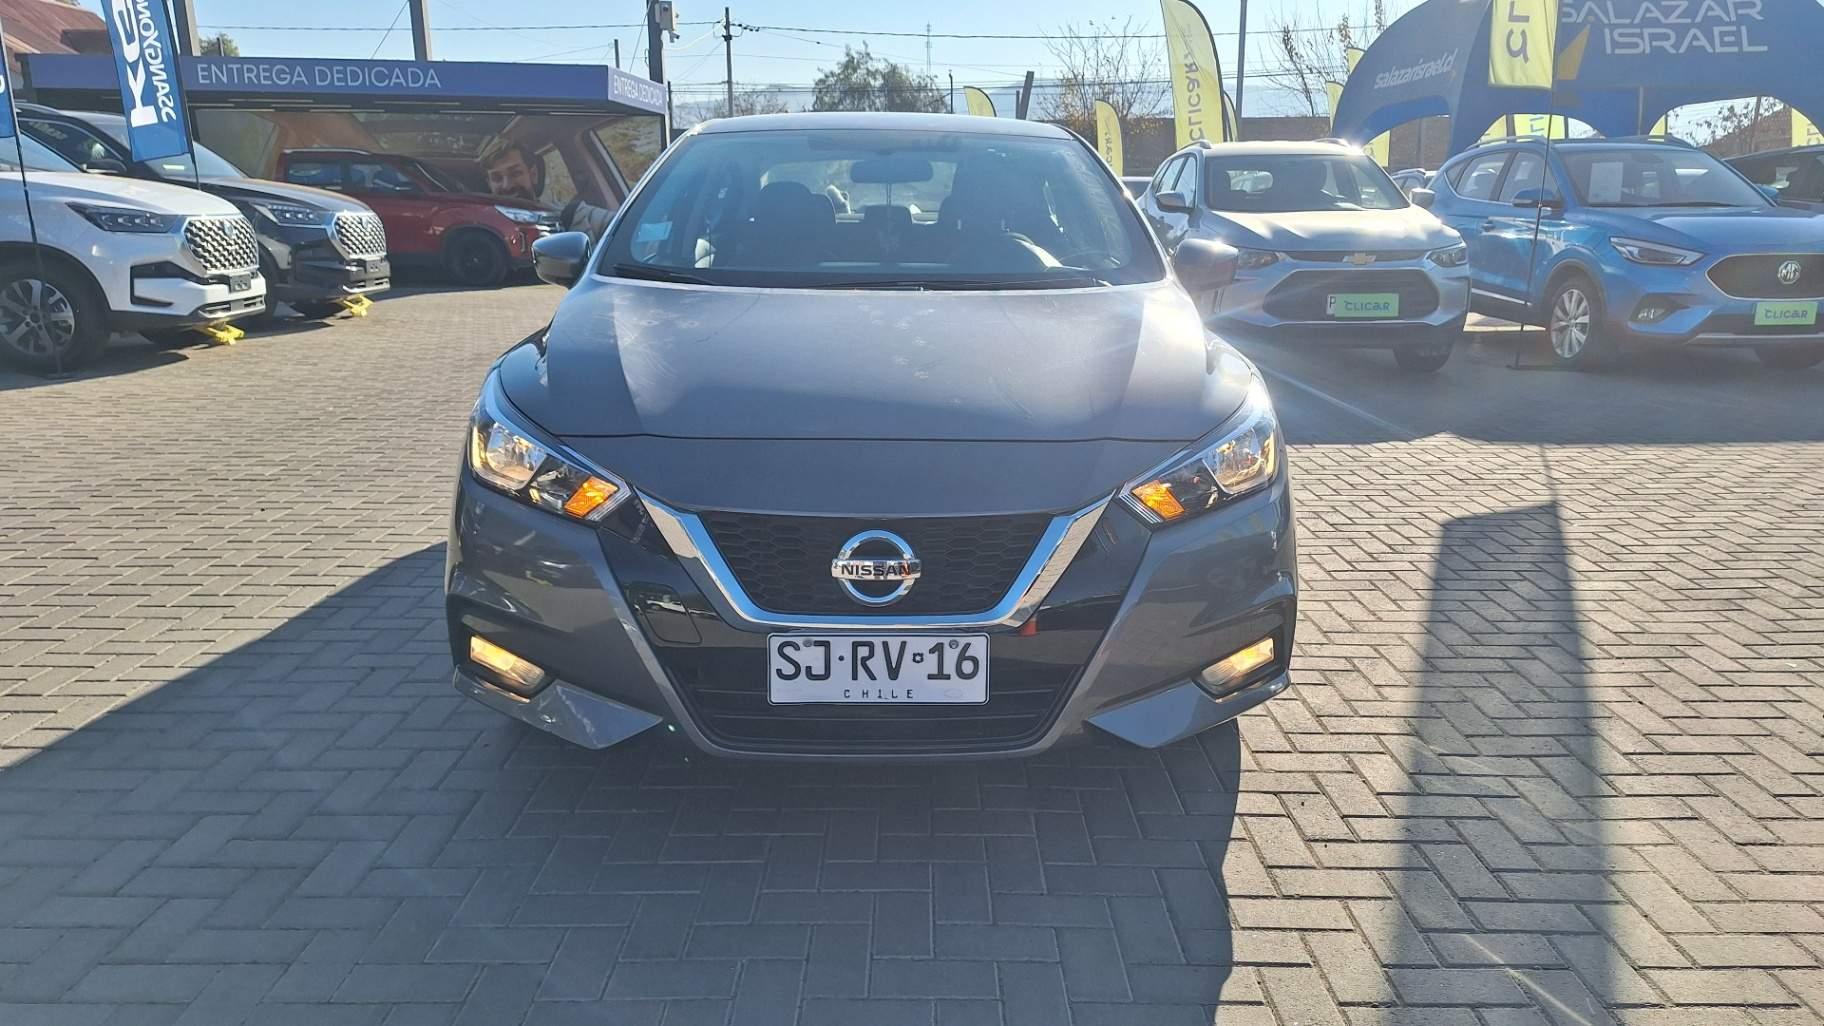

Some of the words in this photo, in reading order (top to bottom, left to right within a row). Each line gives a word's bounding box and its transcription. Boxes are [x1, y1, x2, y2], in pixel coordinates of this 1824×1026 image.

[1561, 0, 1765, 24] SALAZAR
[1604, 25, 1768, 54] ISRAEL
[197, 63, 308, 86] ENTREGA
[314, 66, 442, 88] DEDICADA
[613, 75, 639, 98] ENTREGA
[841, 564, 911, 576] NISSAN
[843, 689, 913, 699] CHILE
